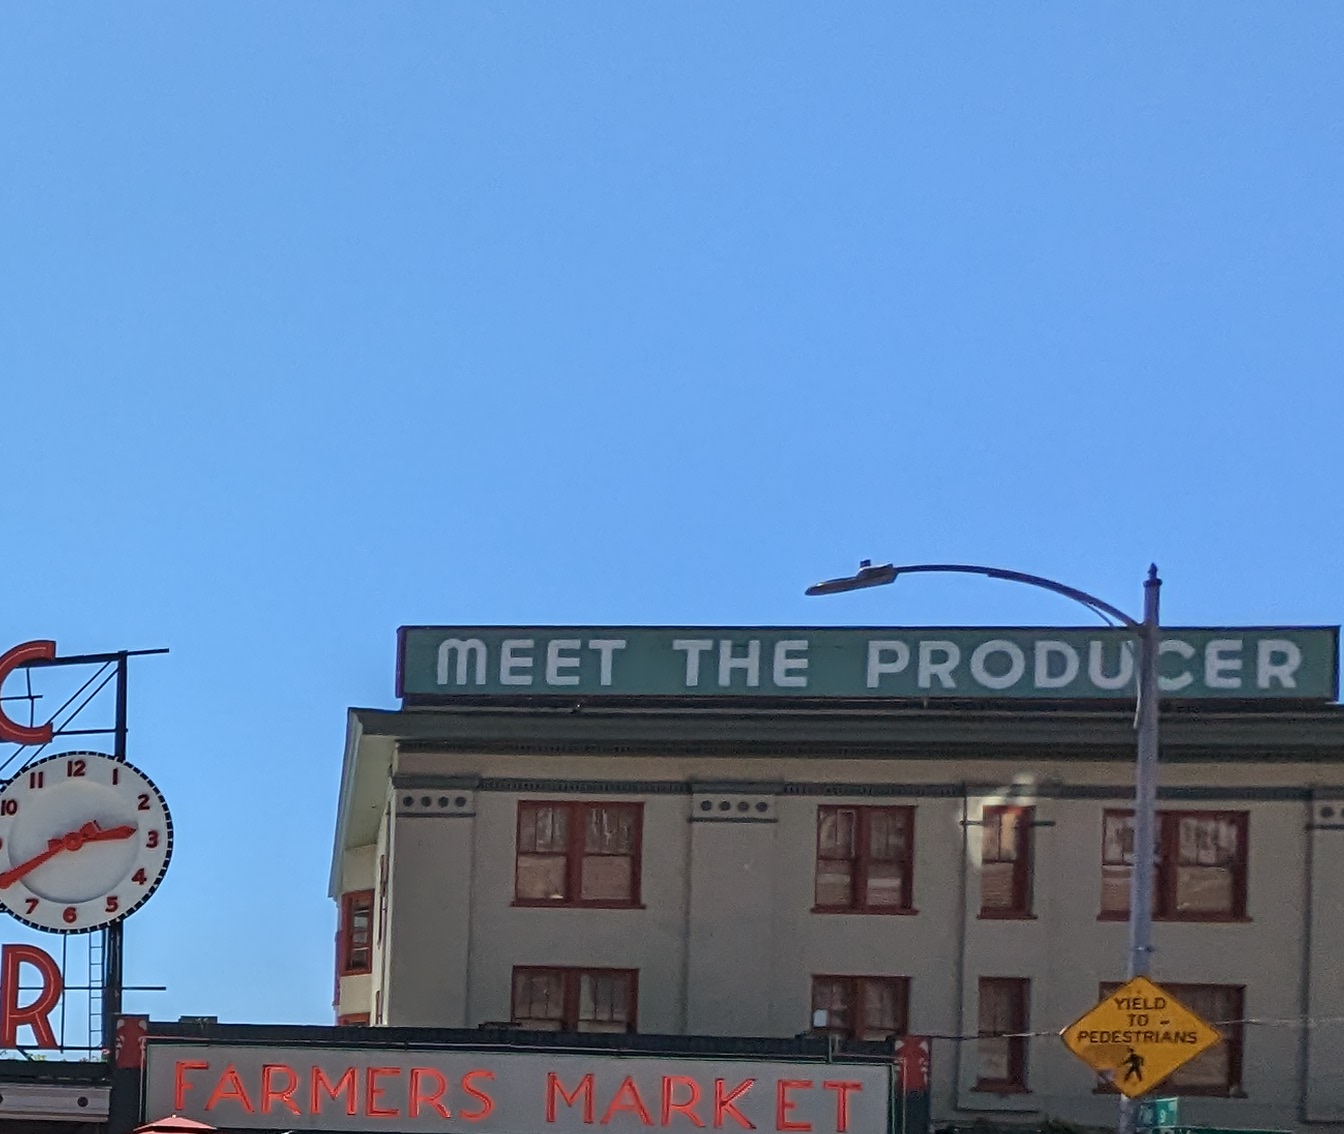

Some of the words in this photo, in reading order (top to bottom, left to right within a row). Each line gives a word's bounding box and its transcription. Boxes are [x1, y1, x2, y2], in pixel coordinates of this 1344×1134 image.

[436, 638, 626, 687] MEET
[673, 638, 809, 688] THE
[866, 638, 1303, 690] PRODUCER
[67, 760, 86, 777] 12
[112, 768, 119, 786] 1
[29, 771, 43, 789] 11
[0, 799, 18, 816] 10
[137, 793, 151, 811] 2
[145, 830, 159, 848] 3
[131, 868, 147, 886] 4
[25, 898, 39, 914] 7
[105, 896, 118, 913] 5
[62, 906, 77, 923] 6
[1114, 998, 1166, 1010] YIELD
[1127, 1014, 1149, 1026] TO
[1078, 1031, 1198, 1043] PEDESTRIANS
[173, 1059, 495, 1121] FARMERS
[545, 1071, 864, 1133] MARKET
